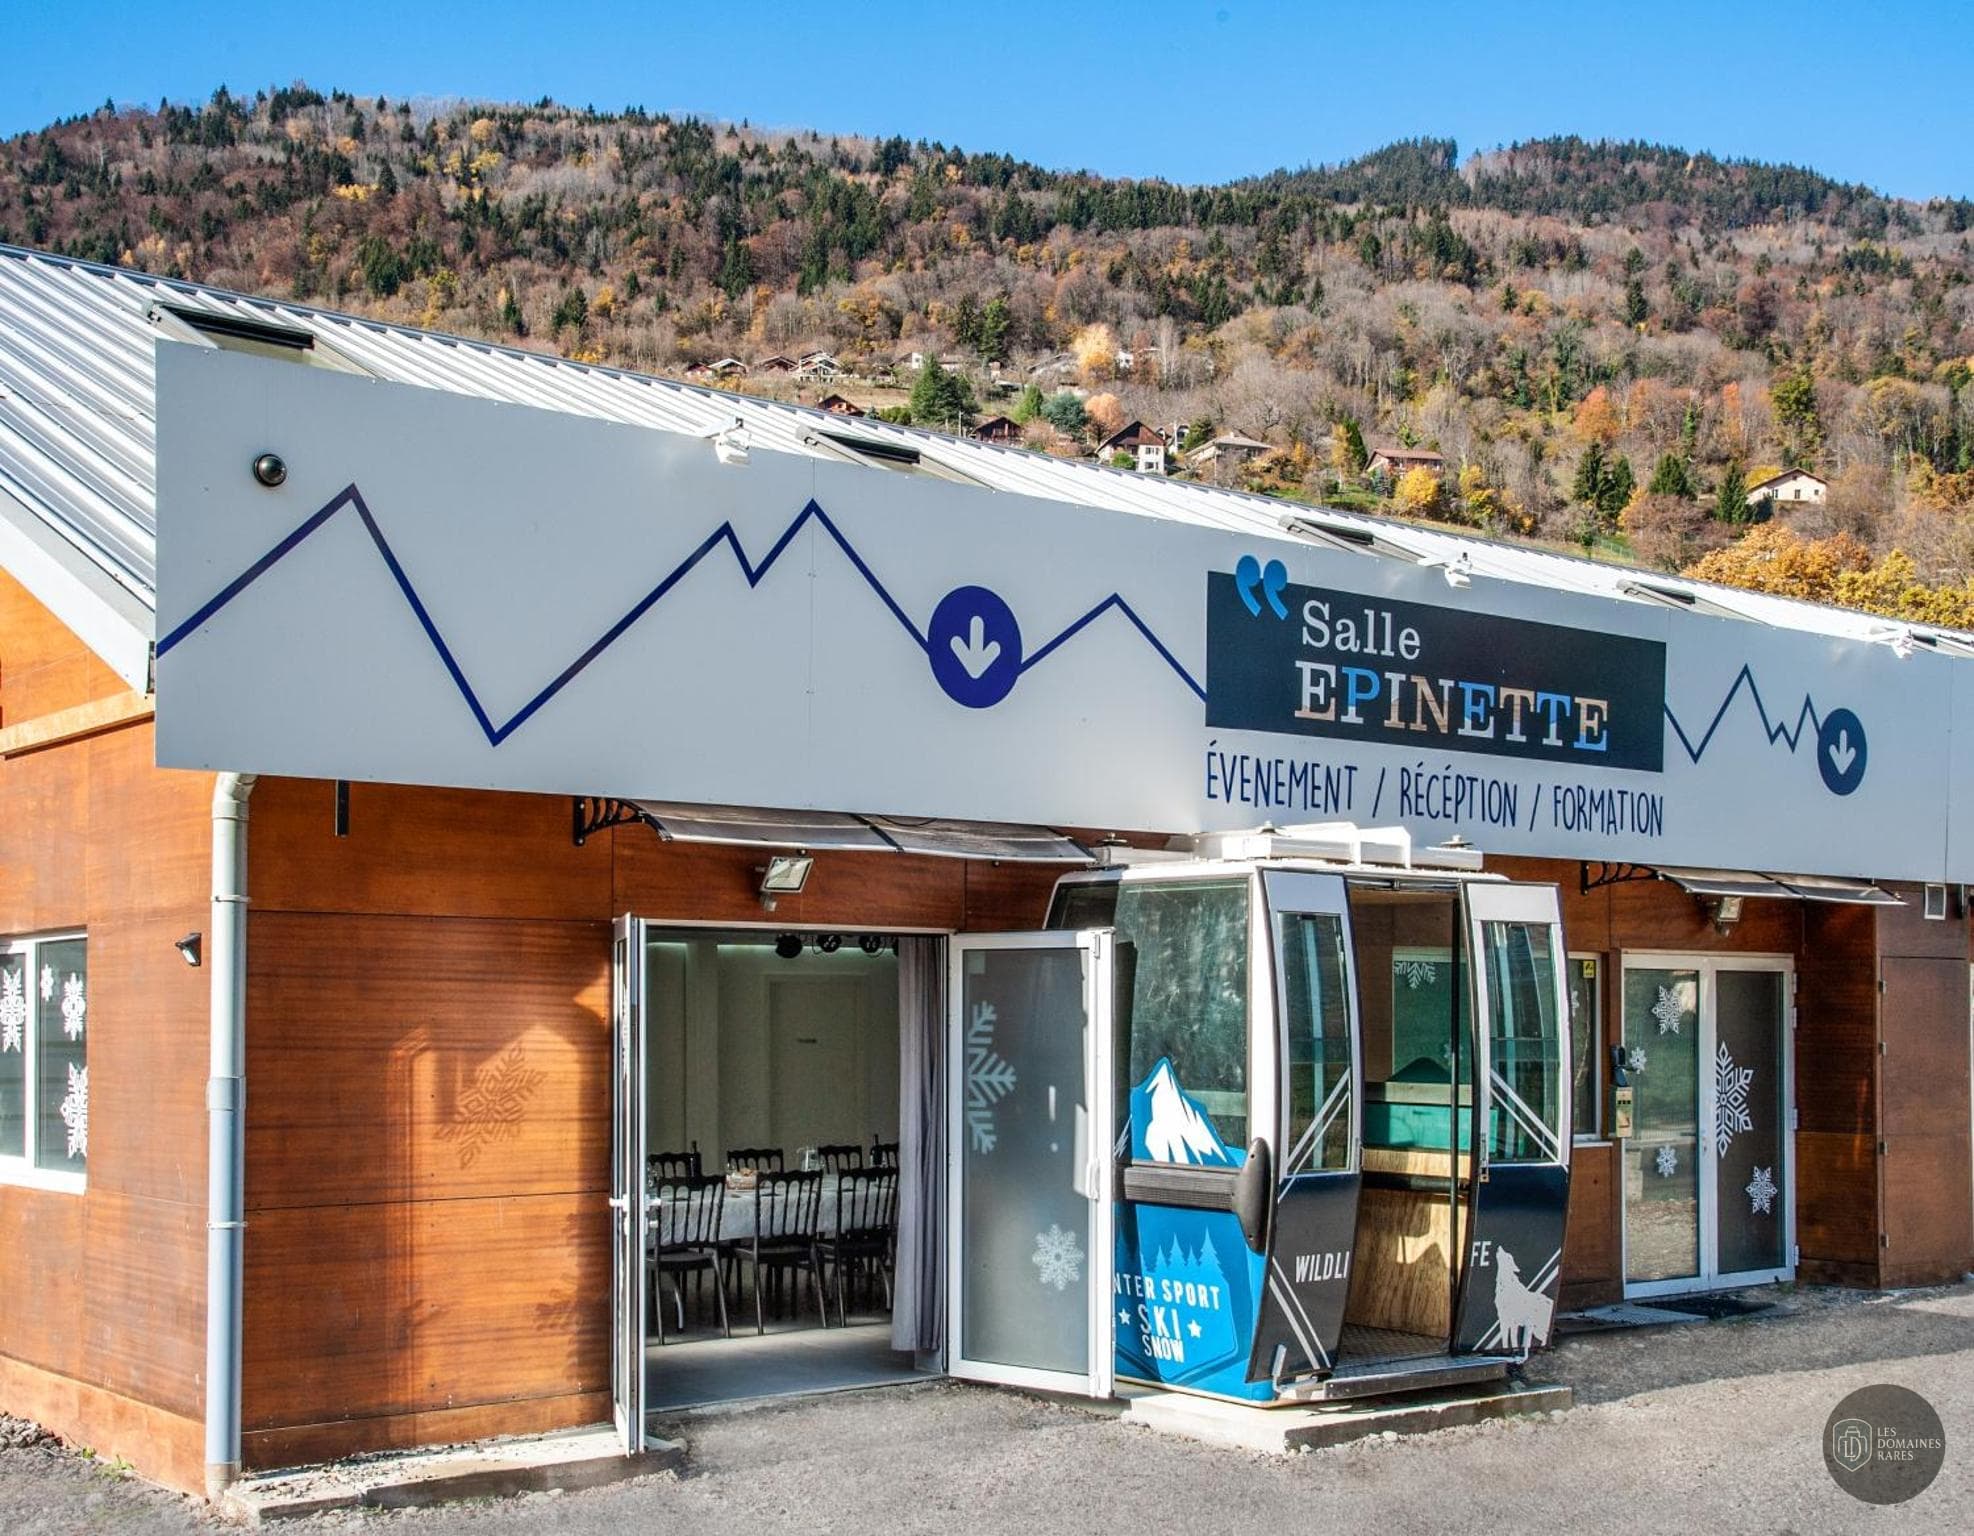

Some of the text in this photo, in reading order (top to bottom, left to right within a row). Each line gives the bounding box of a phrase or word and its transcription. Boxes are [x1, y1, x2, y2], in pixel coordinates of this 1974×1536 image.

[1302, 599, 1421, 660] Salle
[1294, 660, 1609, 752] EPINETTE
[1206, 740, 1664, 837] ÉVENEMENT / RÉCÉPTION / FORMATION
[1295, 1251, 1350, 1283] WILDLI
[1161, 1278, 1220, 1310] SPORT
[1138, 1303, 1181, 1340] SKI
[1142, 1334, 1185, 1363] SNOW
